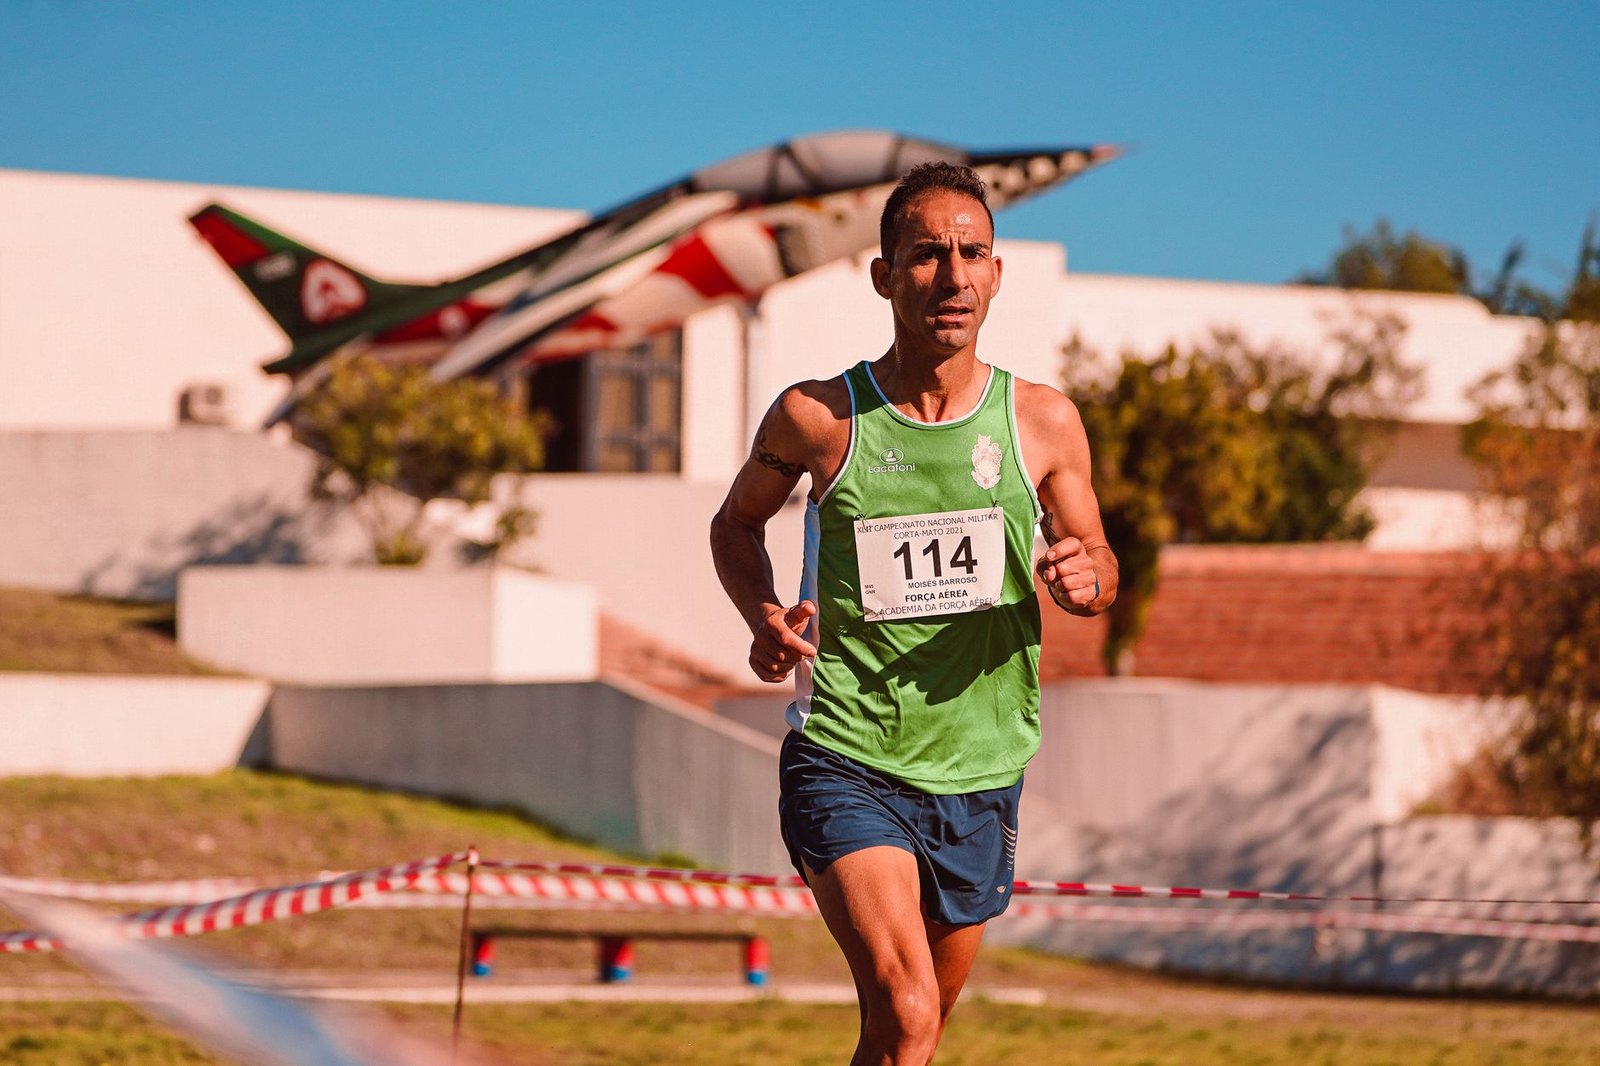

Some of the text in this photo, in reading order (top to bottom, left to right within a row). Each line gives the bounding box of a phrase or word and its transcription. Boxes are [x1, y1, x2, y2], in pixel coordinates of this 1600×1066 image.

[874, 519, 926, 532] CAMPEONATO
[927, 516, 966, 527] NACIONAL
[968, 513, 999, 523] MILITAR
[894, 526, 964, 540] CORTA-MATO 2021
[894, 536, 978, 580] 114
[908, 576, 978, 589] MOISÉS BARROSO
[905, 589, 969, 603] FORÇA AÉREA
[879, 607, 923, 616] ACADEMIA
[925, 604, 938, 612] DA
[939, 600, 967, 612] FORÇA
